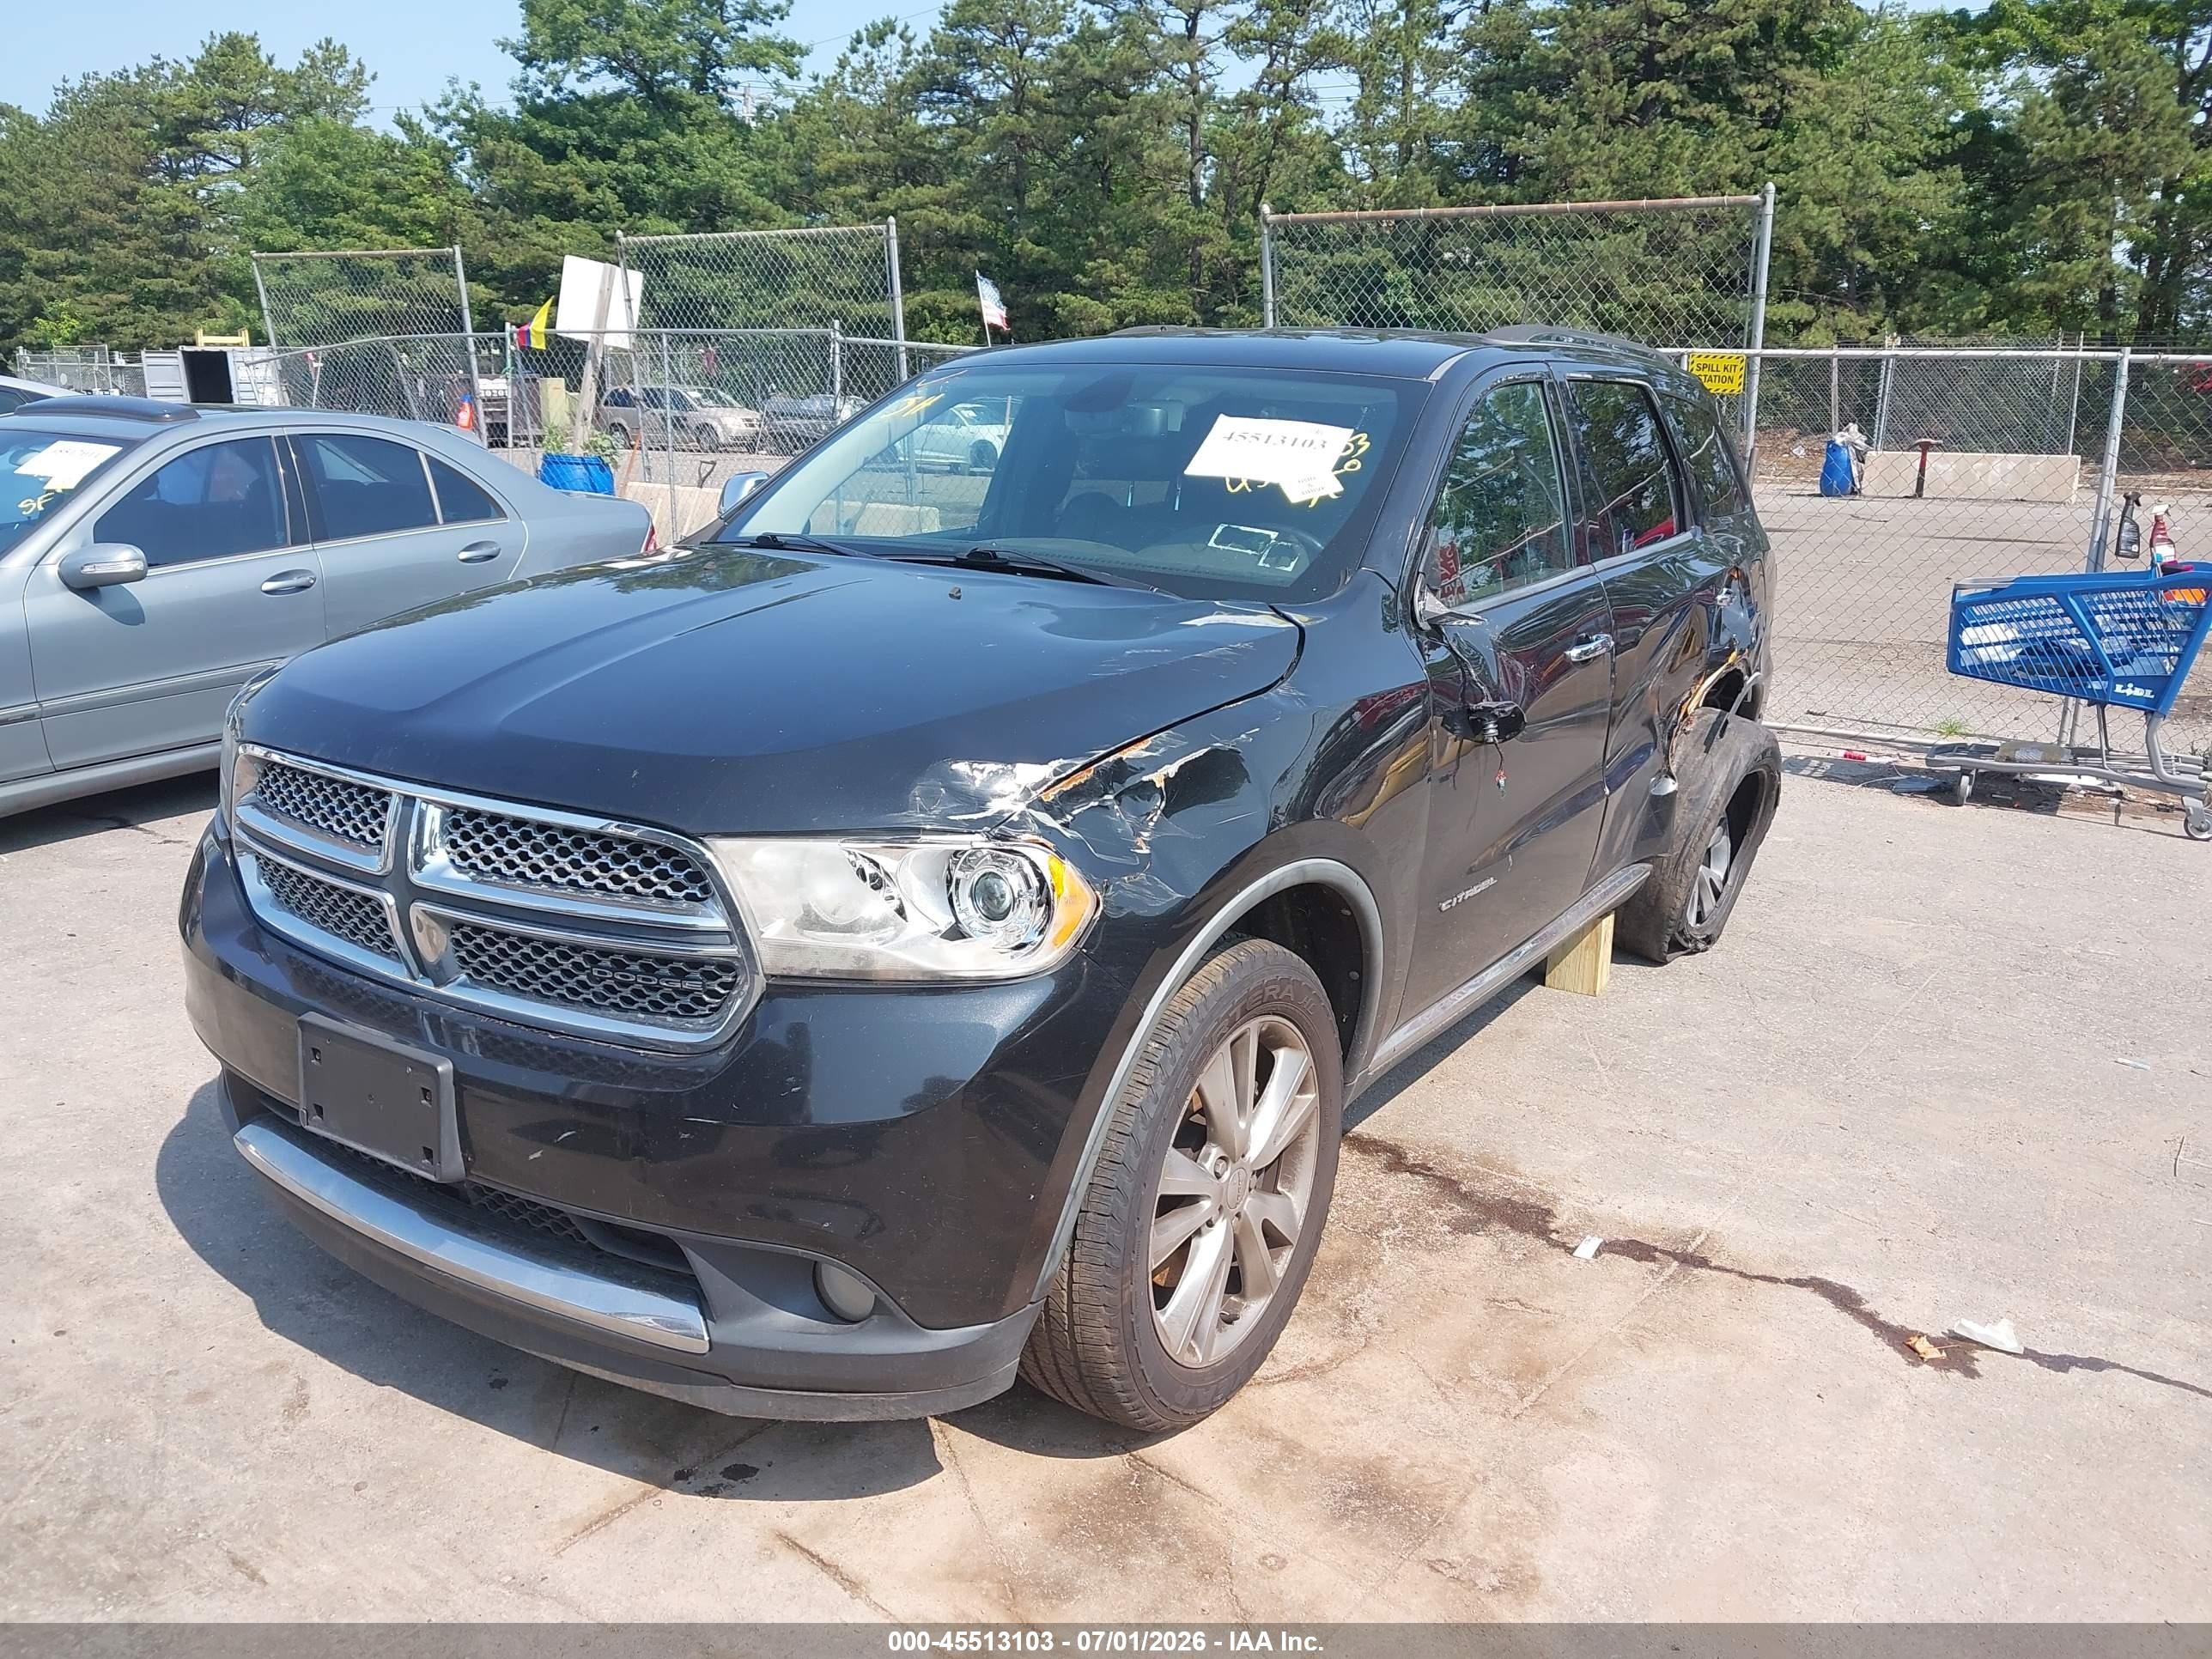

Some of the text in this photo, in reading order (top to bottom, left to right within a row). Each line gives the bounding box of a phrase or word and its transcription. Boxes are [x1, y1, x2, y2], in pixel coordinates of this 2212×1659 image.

[1696, 363, 1738, 373] SPILL KIT
[1223, 431, 1328, 450] 45513103
[1439, 877, 1498, 912] CITADEL
[592, 968, 703, 990] DODGE
